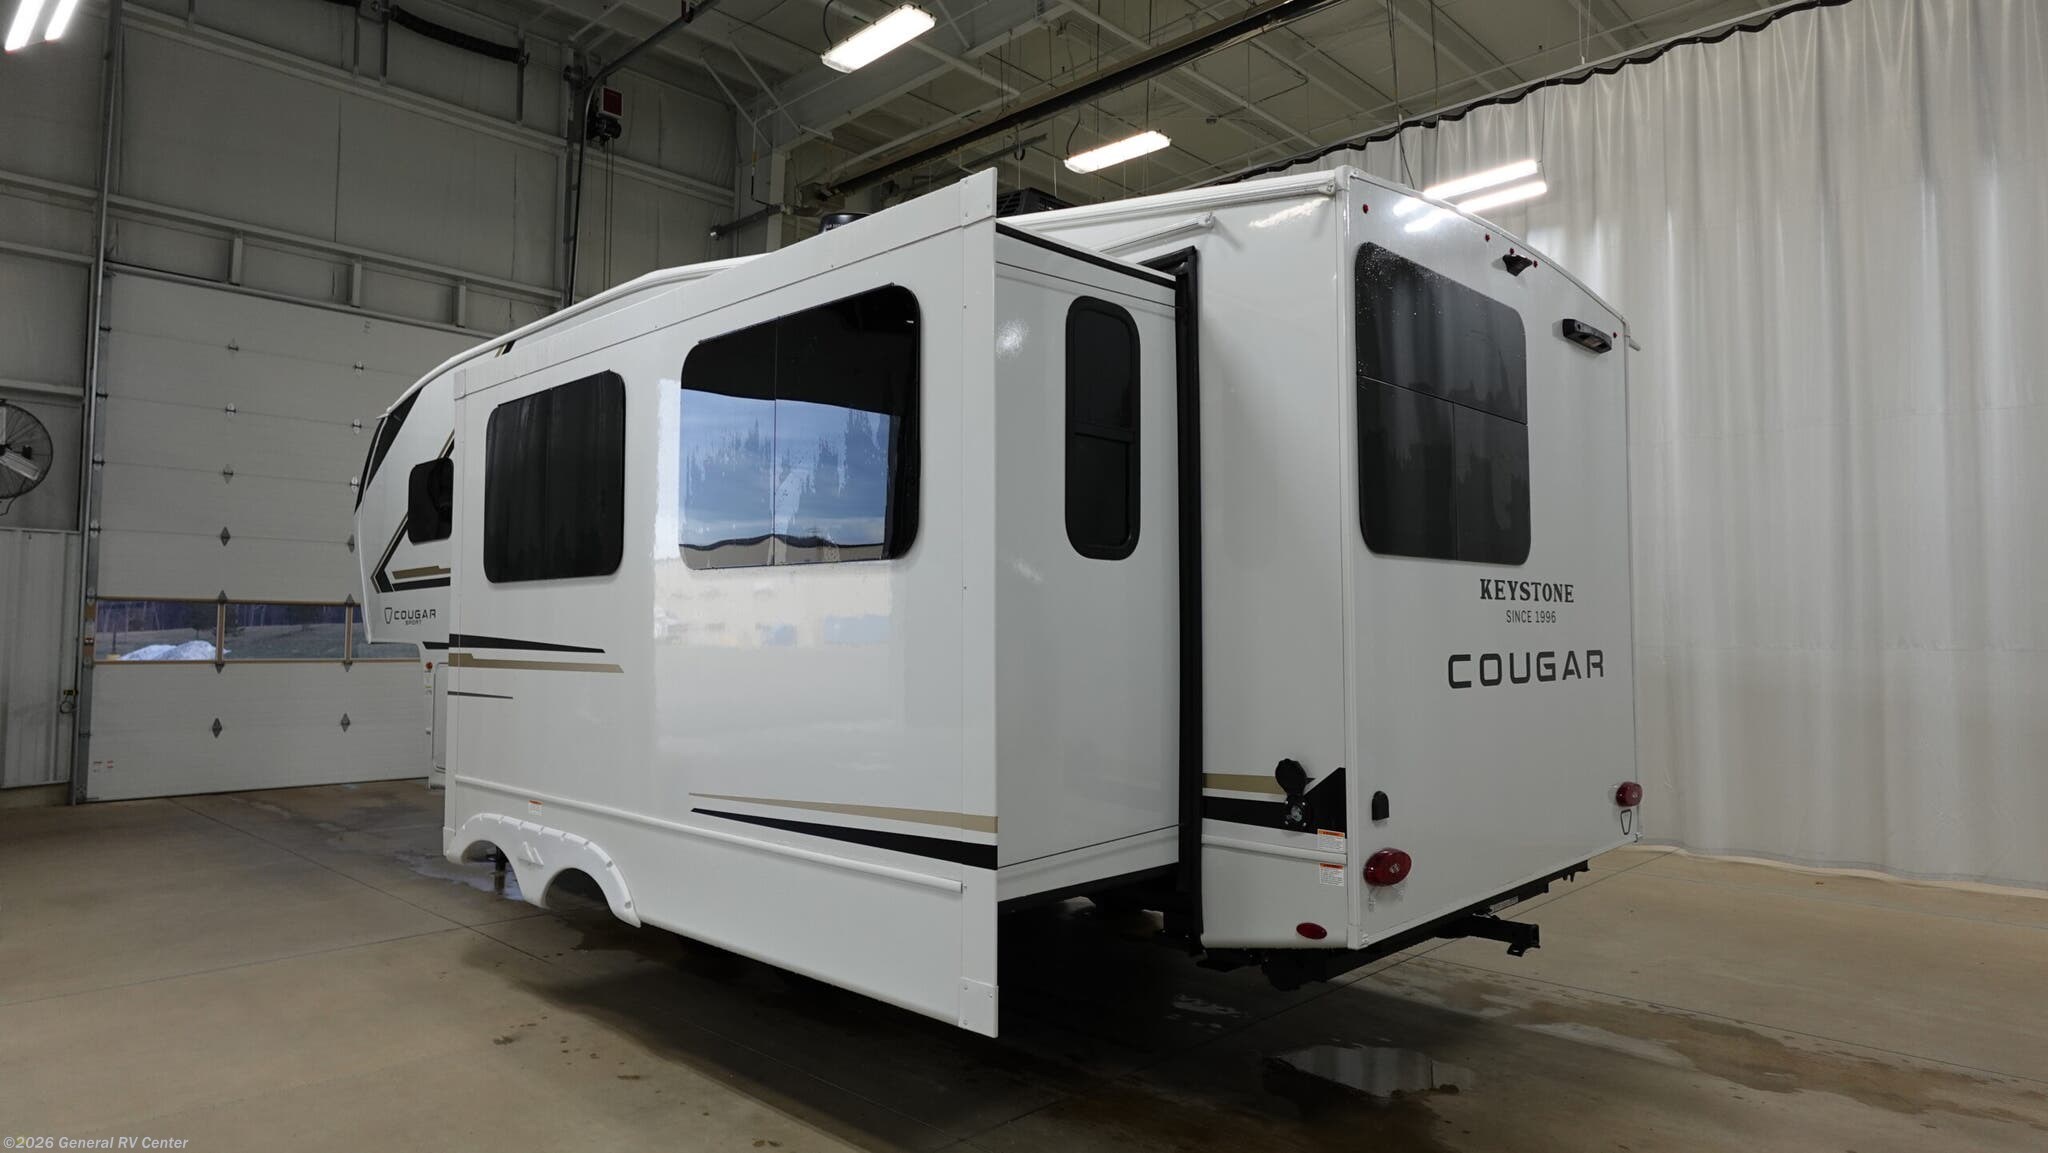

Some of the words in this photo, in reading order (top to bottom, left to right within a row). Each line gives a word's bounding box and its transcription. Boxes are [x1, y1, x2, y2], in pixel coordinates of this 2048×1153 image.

[1480, 578, 1574, 603] KEYSTONE
[394, 609, 437, 620] COUGAR
[1506, 609, 1532, 623] SINCE
[1535, 610, 1556, 624] 1996
[1448, 649, 1604, 689] COUGAR
